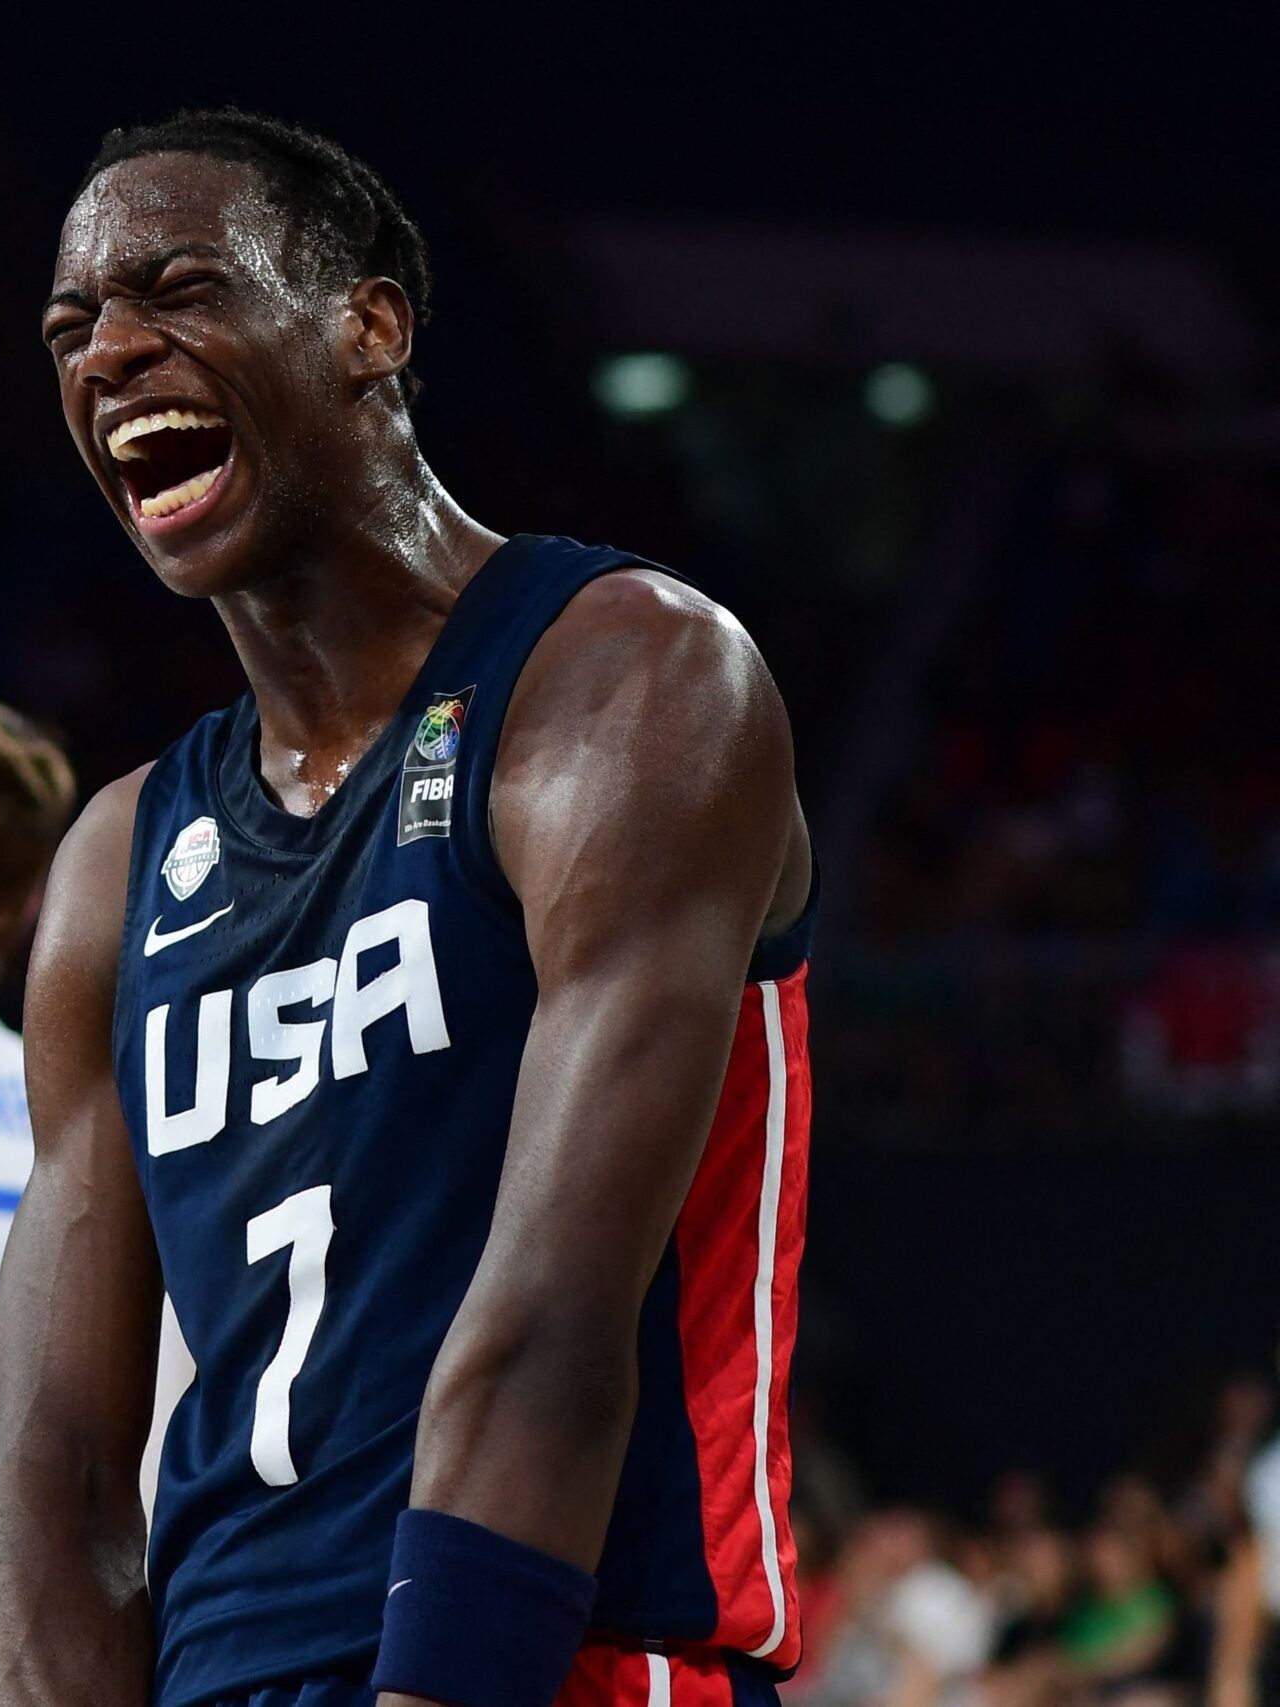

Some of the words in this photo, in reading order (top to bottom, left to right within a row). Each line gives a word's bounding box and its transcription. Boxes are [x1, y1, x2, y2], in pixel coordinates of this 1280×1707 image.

[411, 774, 454, 803] FIBA
[144, 899, 451, 1157] USA
[247, 1185, 335, 1486] 7
